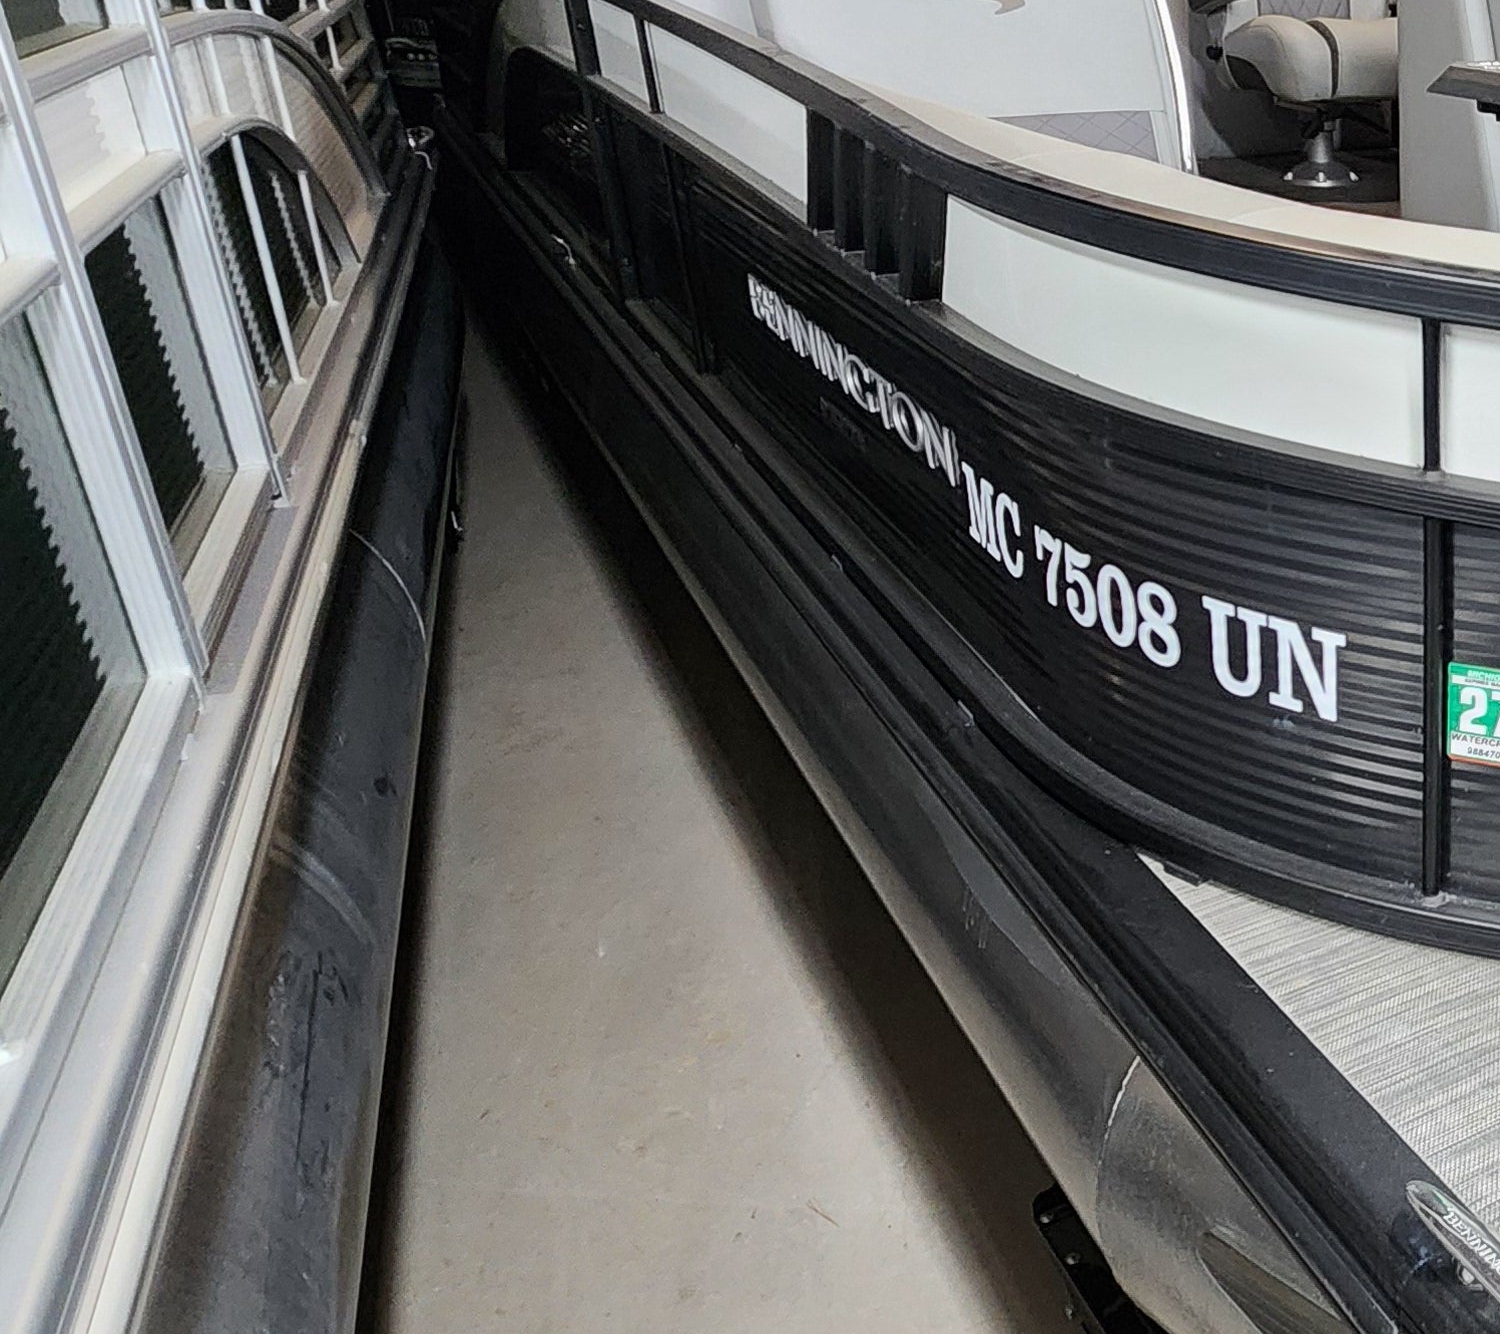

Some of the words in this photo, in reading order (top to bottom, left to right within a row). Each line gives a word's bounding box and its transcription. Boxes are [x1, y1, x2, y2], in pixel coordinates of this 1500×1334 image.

[747, 272, 960, 487] BENNINGTON
[961, 462, 1024, 578] MC
[1033, 524, 1181, 667] 7508
[1202, 596, 1346, 722] UN
